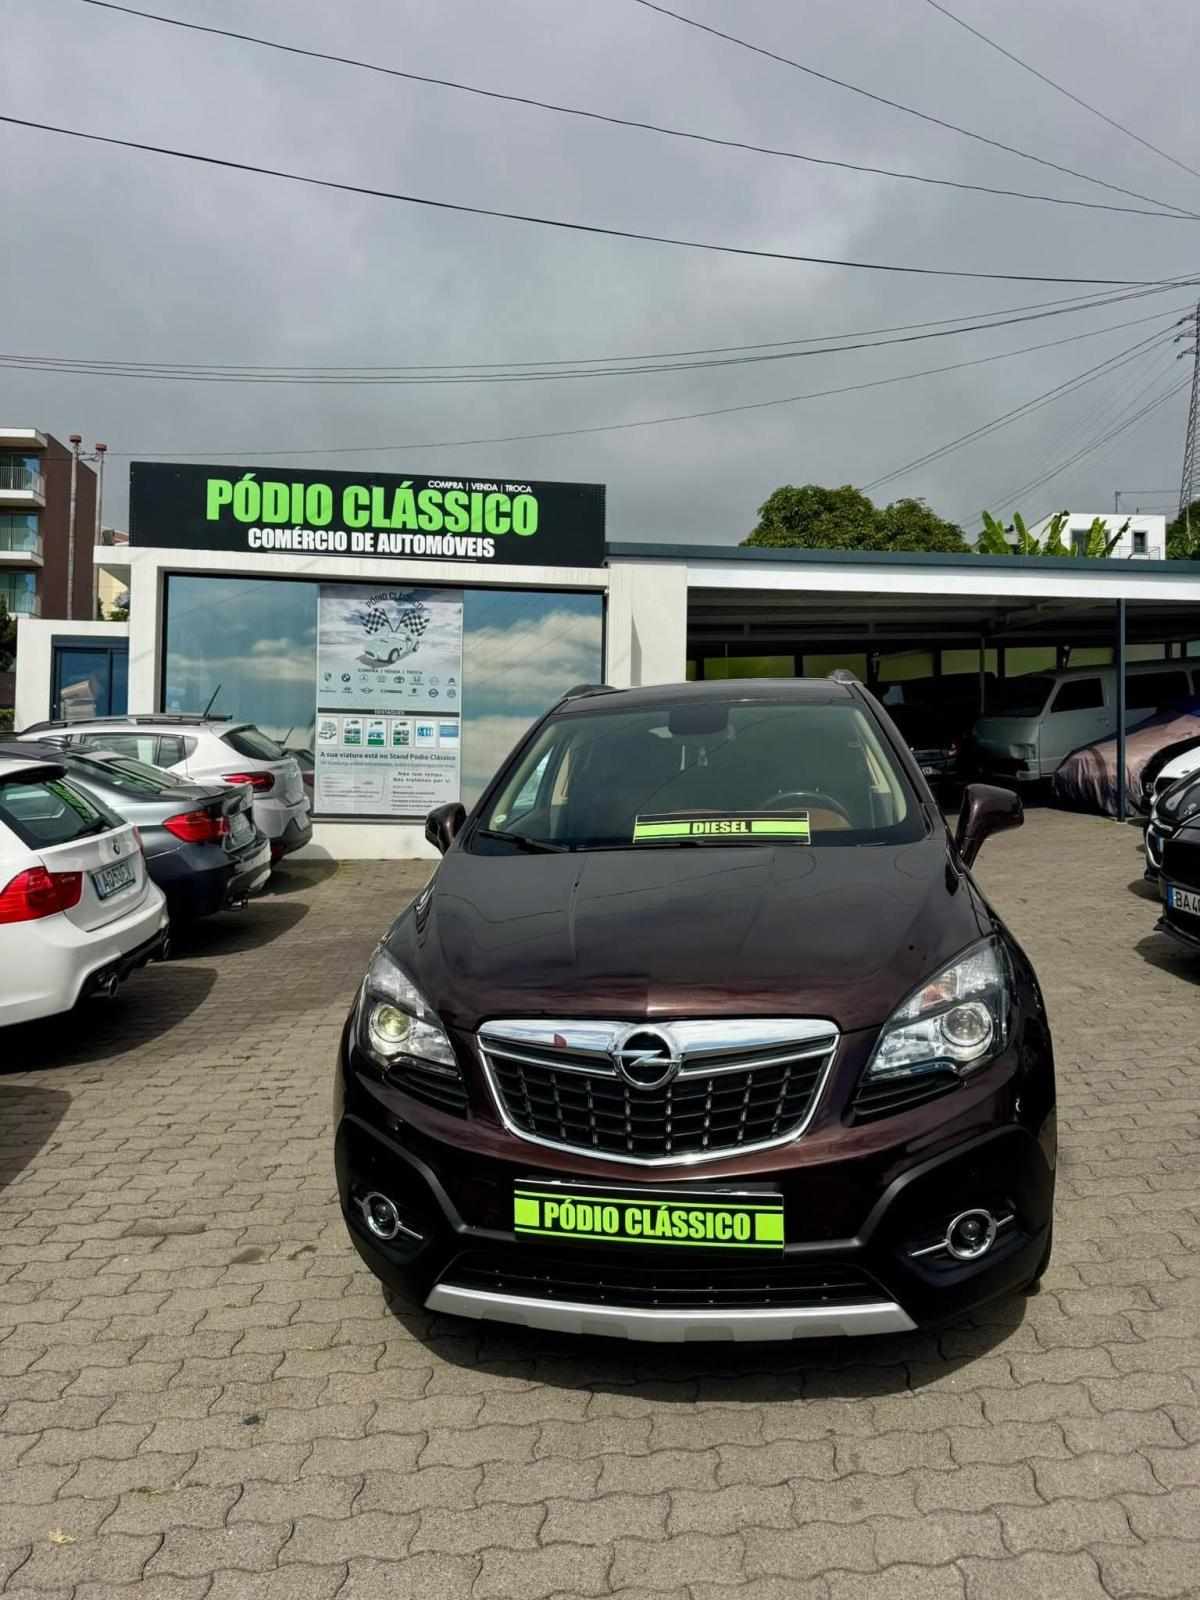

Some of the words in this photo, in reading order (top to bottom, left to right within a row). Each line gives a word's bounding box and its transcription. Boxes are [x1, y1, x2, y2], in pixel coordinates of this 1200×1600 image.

[428, 480, 464, 489] COMPRA
[471, 482, 499, 491] VENDA
[505, 484, 533, 493] TROCA
[206, 472, 333, 526] PÓDIO
[342, 481, 539, 536] CLÁSSICO
[247, 526, 348, 552] COMÉRCIO
[351, 532, 375, 552] DE
[377, 532, 496, 558] AUTOMÓVEIS
[692, 821, 749, 834] DIESEL
[1176, 891, 1191, 911] BA
[1192, 895, 1200, 914] 4
[544, 1198, 619, 1234] PÓDIO
[625, 1203, 751, 1240] CLÁSSICO
